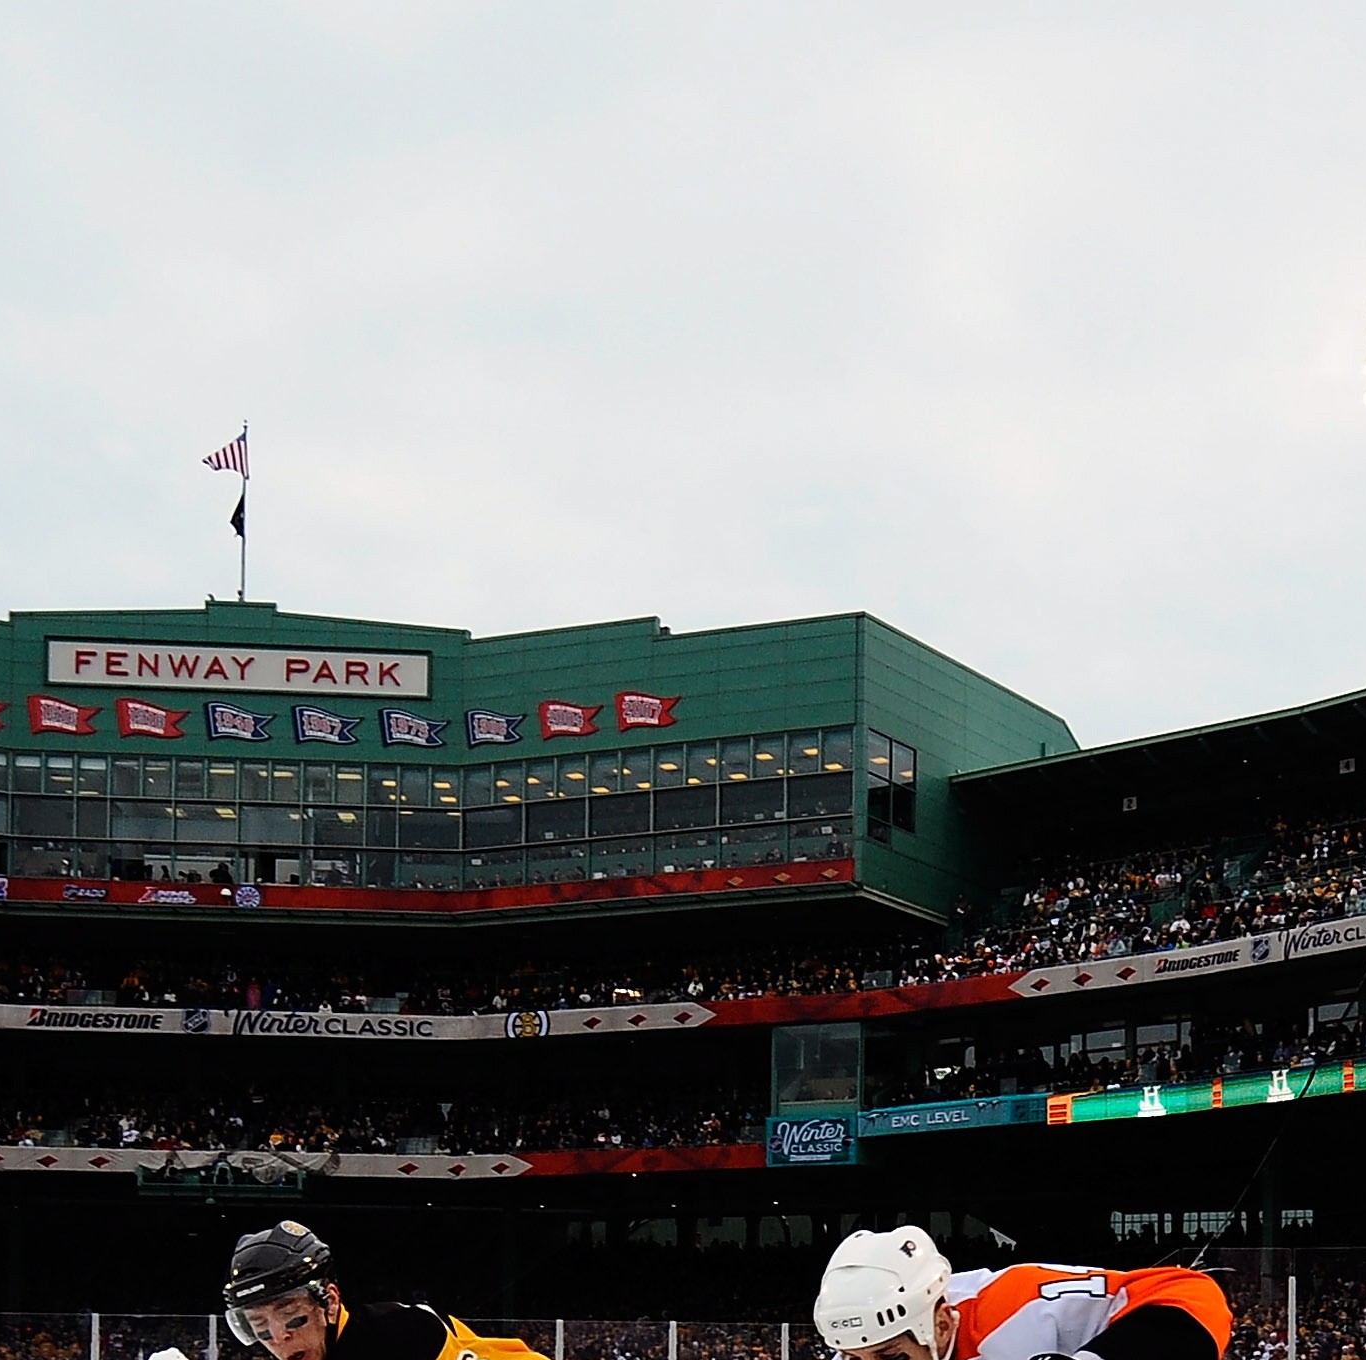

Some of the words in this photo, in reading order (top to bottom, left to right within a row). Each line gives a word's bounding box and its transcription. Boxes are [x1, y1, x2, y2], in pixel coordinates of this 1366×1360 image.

[74, 649, 256, 682] FENWAY
[284, 657, 402, 687] PARK
[1277, 922, 1343, 959] Winter
[1154, 949, 1240, 975] BRIDGESTONE
[26, 1008, 163, 1030] BRIDGESTONE
[232, 1010, 324, 1036] Winter
[324, 1018, 434, 1037] CLASSIC
[891, 1114, 920, 1128] EMC
[926, 1110, 970, 1125] LEVEL
[776, 1119, 846, 1155] Winter
[790, 1142, 843, 1154] CLASSIC
[830, 1317, 863, 1328] CCM
